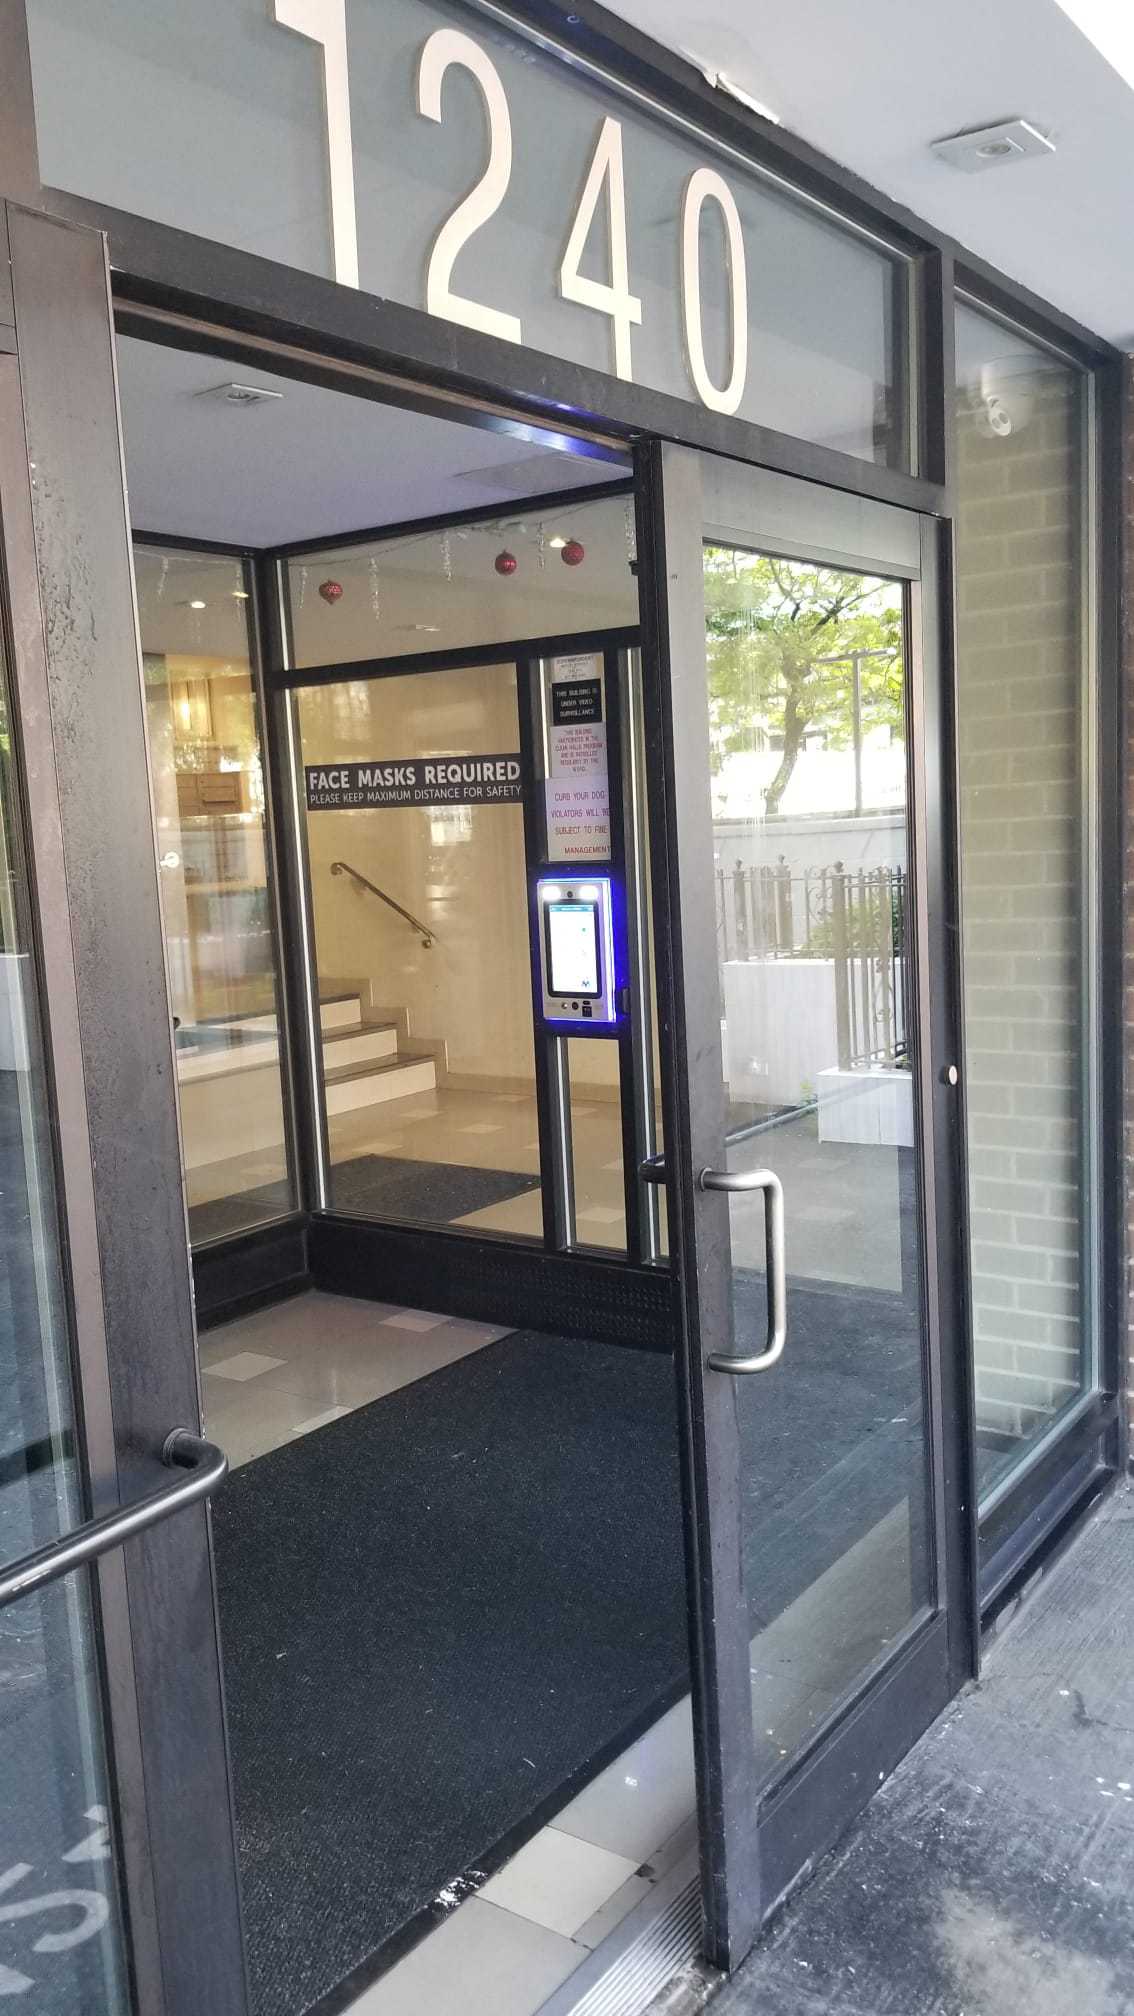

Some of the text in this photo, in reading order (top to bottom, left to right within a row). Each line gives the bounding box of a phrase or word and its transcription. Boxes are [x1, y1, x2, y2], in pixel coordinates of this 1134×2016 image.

[274, 0, 748, 417] 1240
[309, 761, 520, 790] FACE MASKS REQUIRED
[310, 785, 522, 804] PLEASE KEEP MAXIMUM DISTANCE FOR SAFETY
[574, 791, 589, 801] YOUR
[551, 809, 583, 818] VIOLATORS
[586, 808, 600, 817] WILL
[555, 826, 580, 835] SUBJECT
[584, 826, 592, 834] TO
